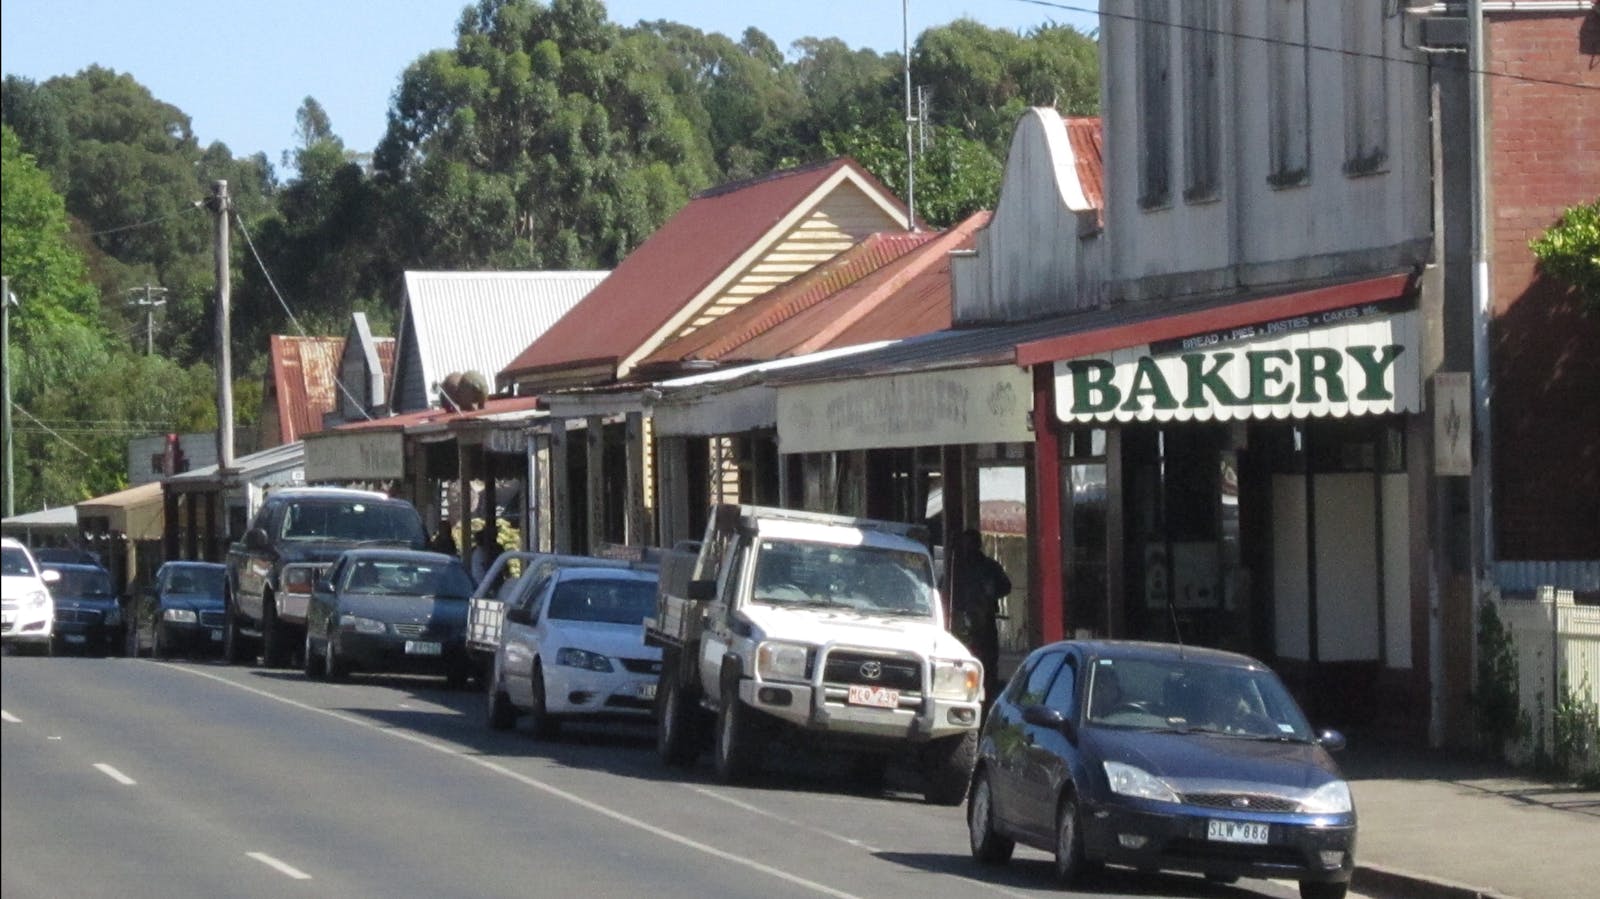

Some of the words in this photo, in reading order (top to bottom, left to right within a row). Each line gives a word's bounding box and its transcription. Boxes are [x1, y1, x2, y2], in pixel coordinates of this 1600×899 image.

[1183, 334, 1219, 349] BREAD
[1232, 328, 1255, 341] PIES
[1267, 318, 1310, 334] PASTIES
[1322, 307, 1359, 323] CAKES
[1066, 344, 1405, 414] BAKERY
[1209, 822, 1236, 838] SLW
